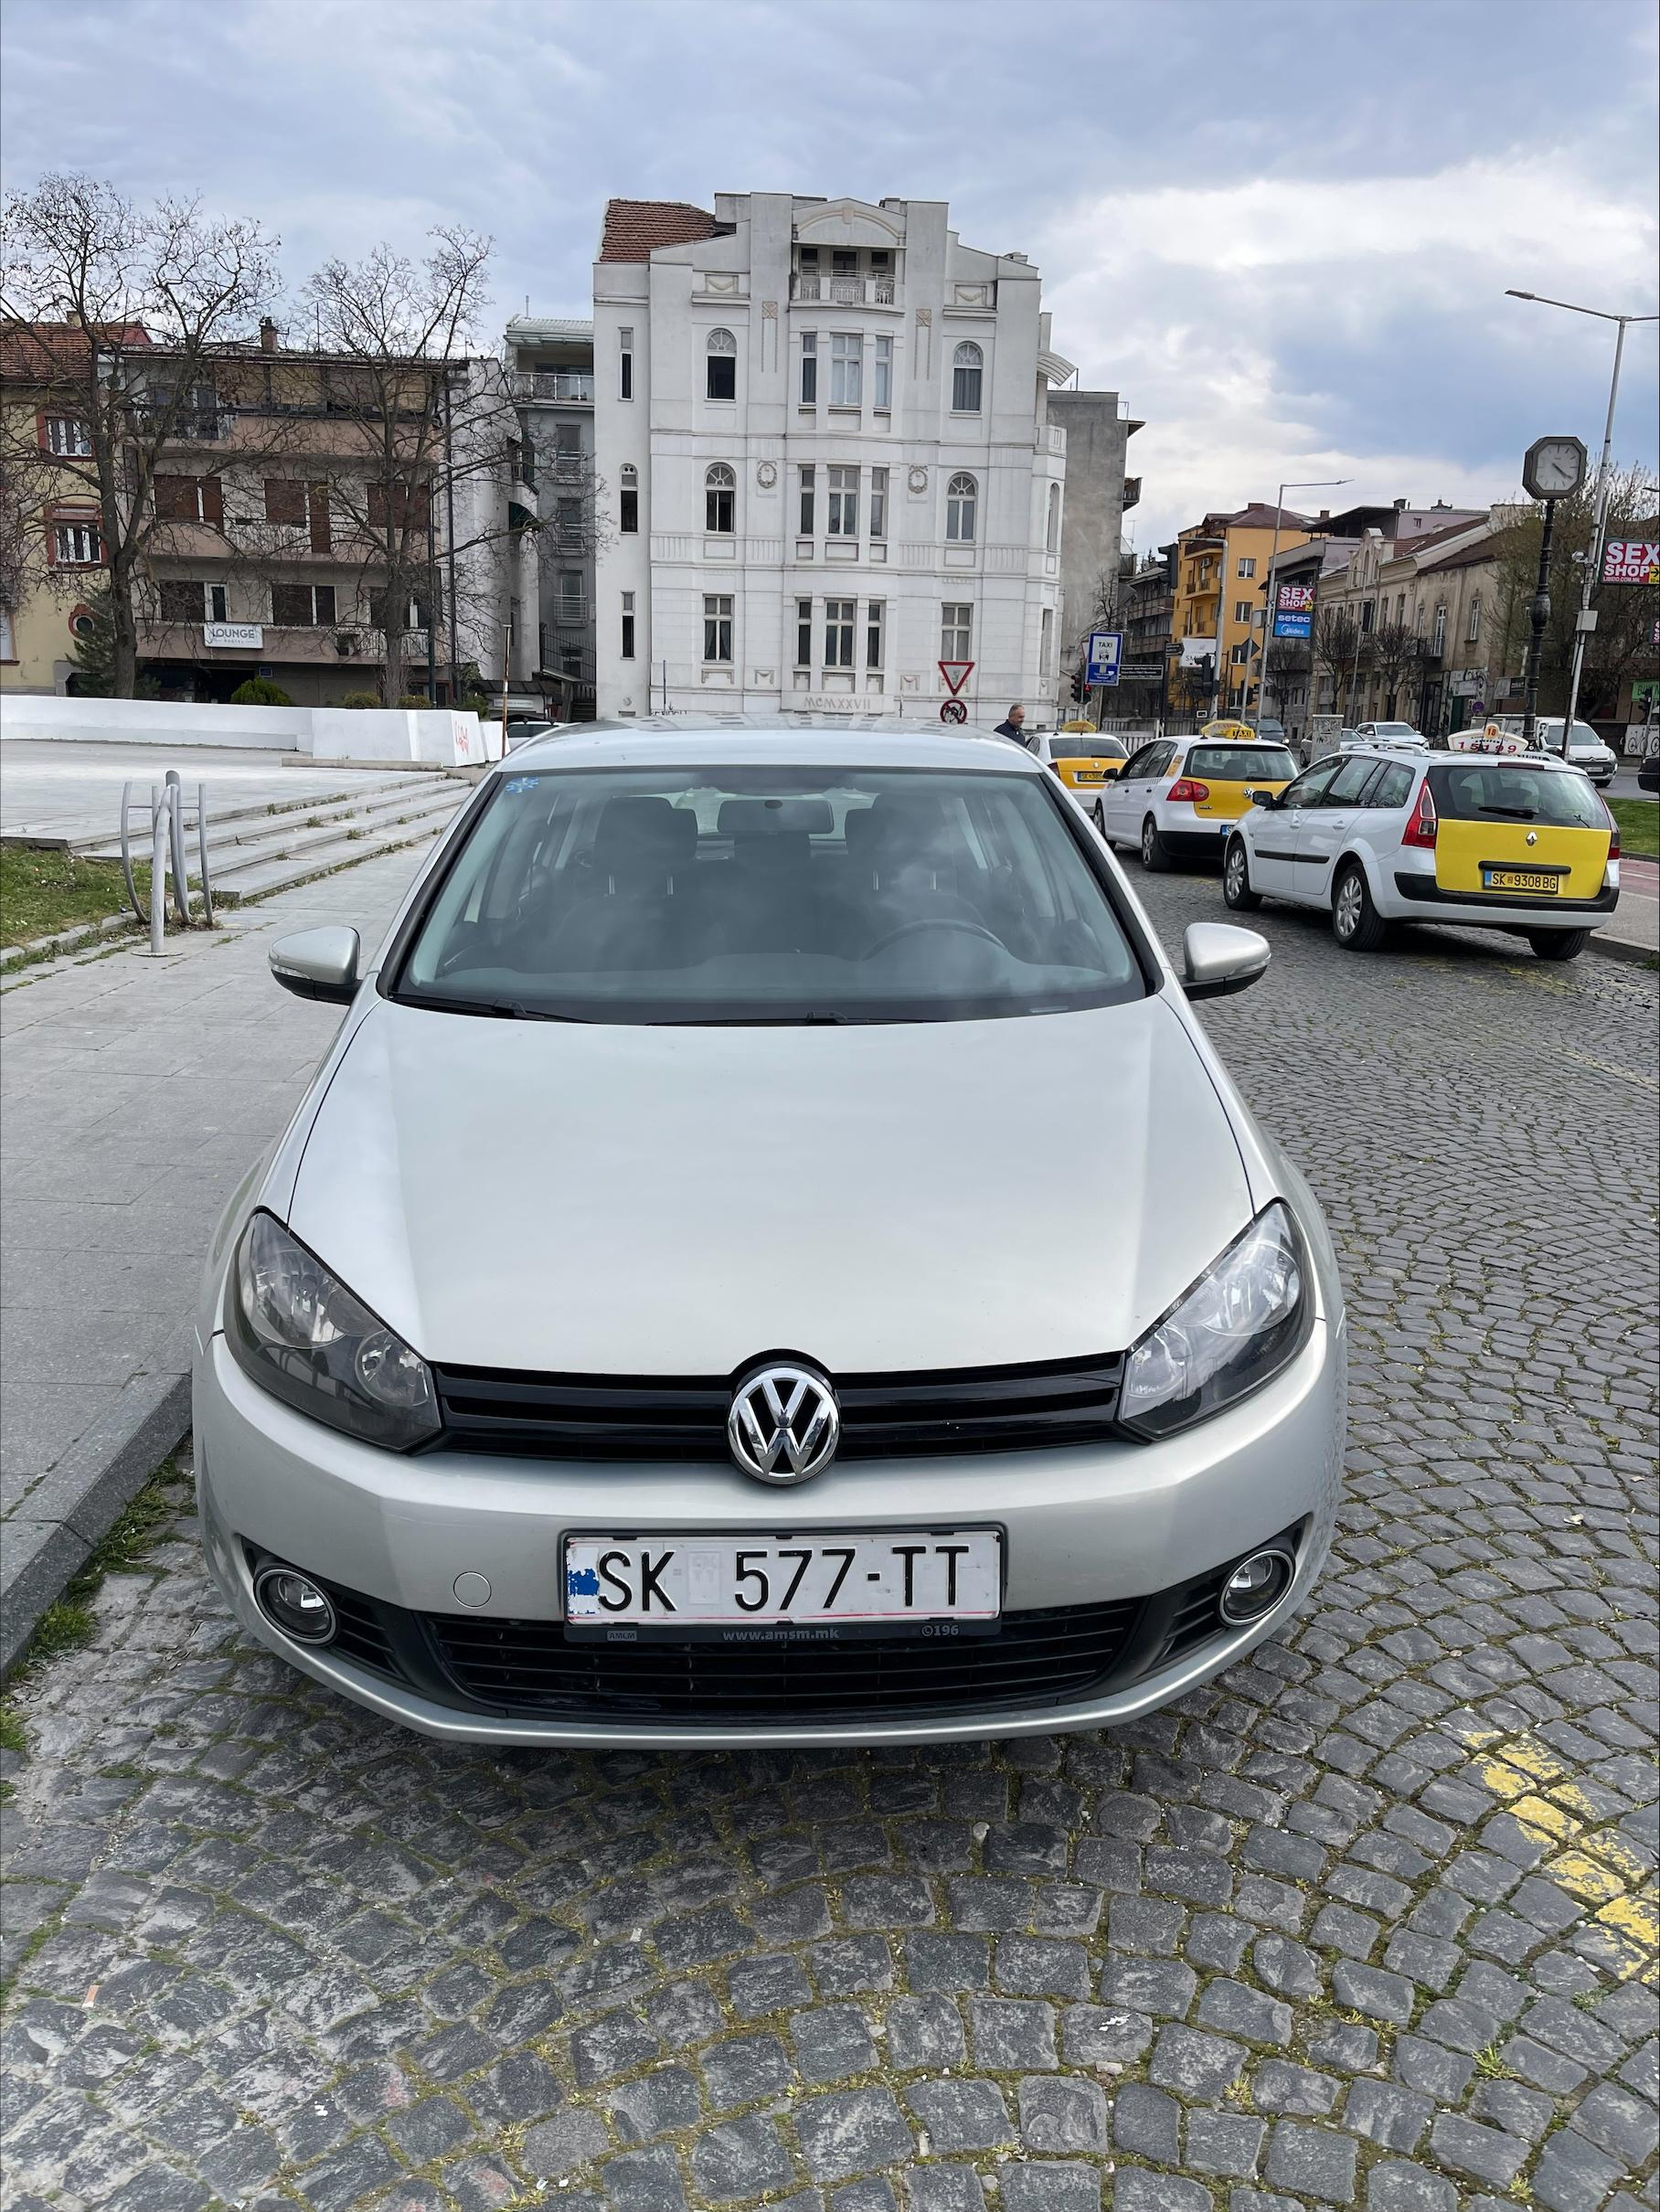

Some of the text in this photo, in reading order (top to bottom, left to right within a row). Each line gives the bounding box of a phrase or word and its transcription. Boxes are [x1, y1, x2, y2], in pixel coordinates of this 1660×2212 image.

[1606, 542, 1659, 565] SEX
[1604, 564, 1649, 577] SHOP
[1280, 586, 1314, 601] SEX
[1280, 599, 1305, 607] SHOP
[1278, 614, 1311, 622] setec
[212, 628, 255, 639] LOUNGE
[804, 697, 871, 710] MCMXXVII
[1487, 728, 1496, 736] 18
[1492, 873, 1506, 886] SK
[598, 1551, 677, 1611] SK
[722, 1628, 840, 1641] www.amsm.mk
